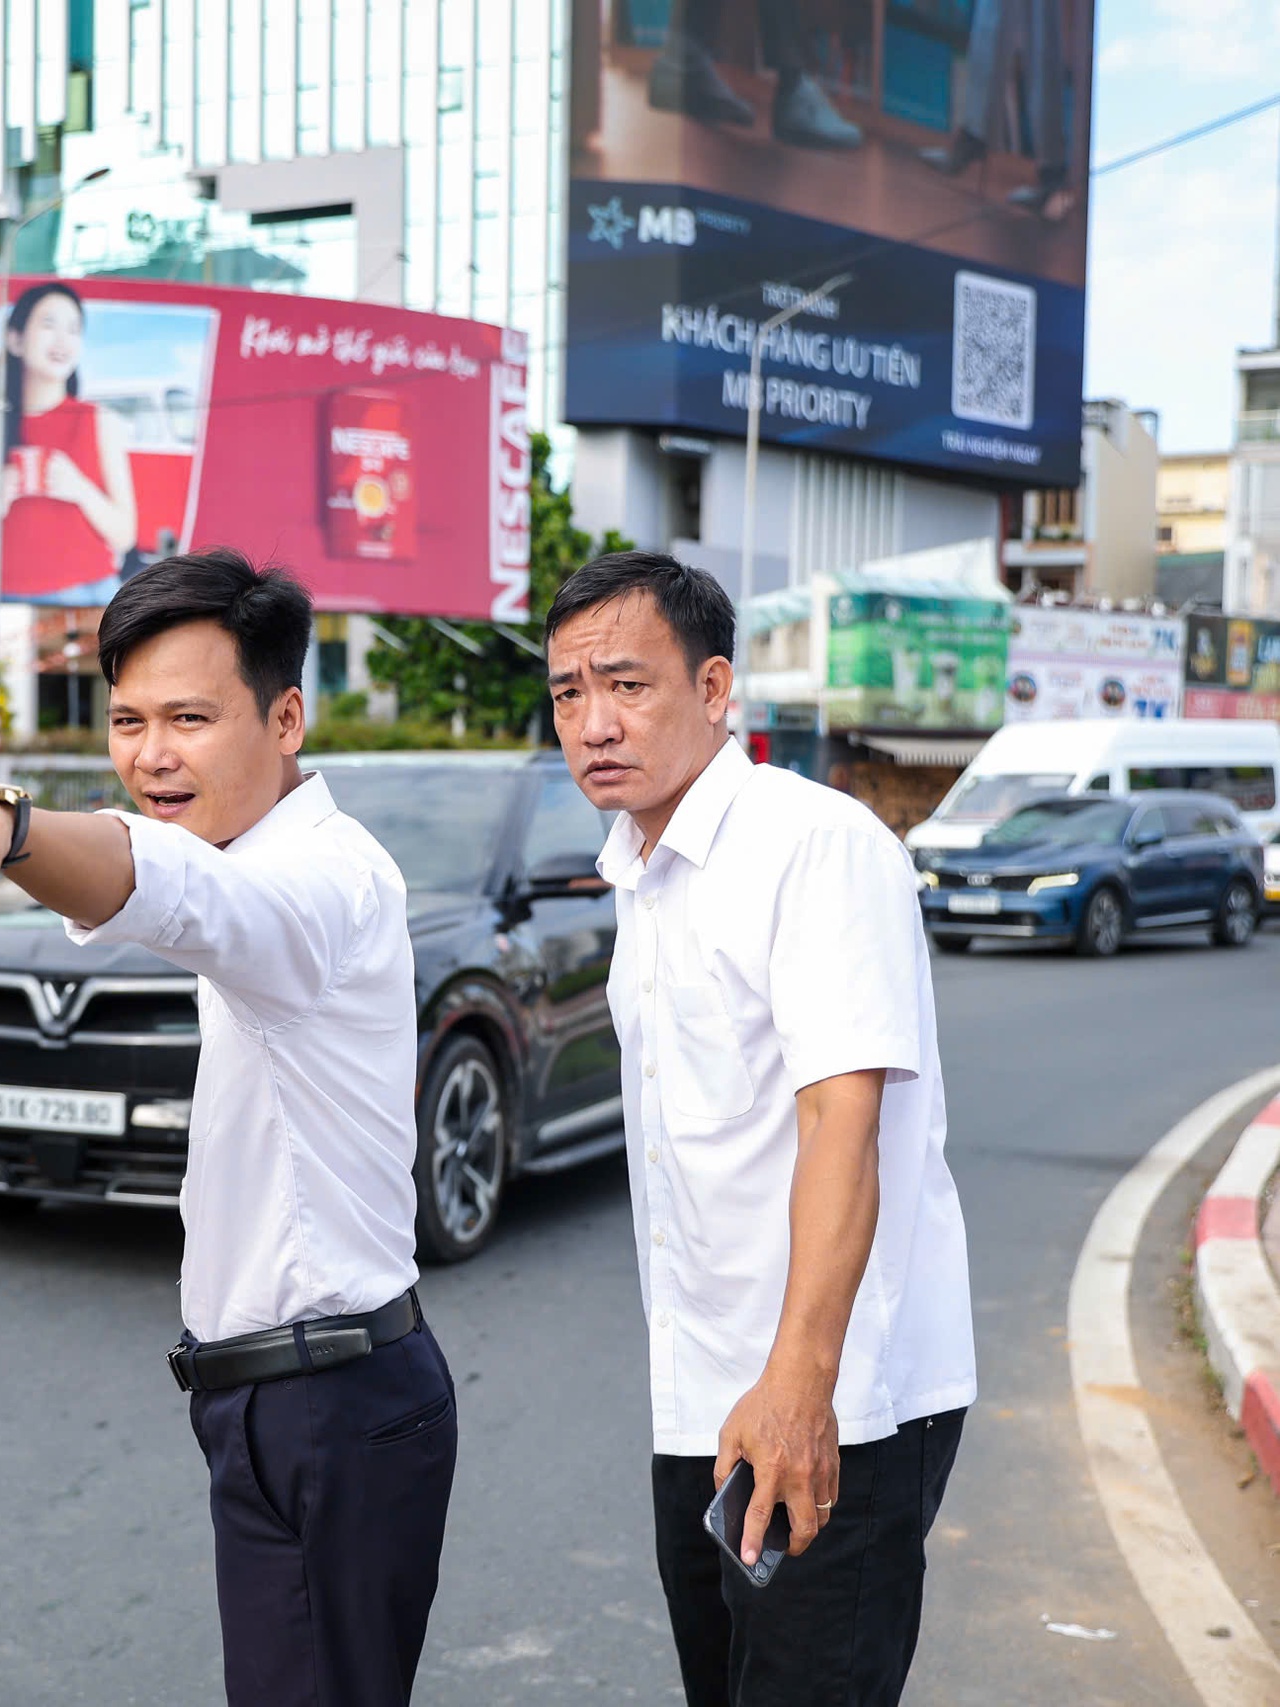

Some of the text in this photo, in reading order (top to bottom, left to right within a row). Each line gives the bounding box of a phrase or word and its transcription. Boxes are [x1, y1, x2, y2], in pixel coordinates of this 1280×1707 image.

[638, 205, 696, 246] MB
[661, 302, 756, 355] KHÁCH
[765, 375, 872, 431] PRIORITY
